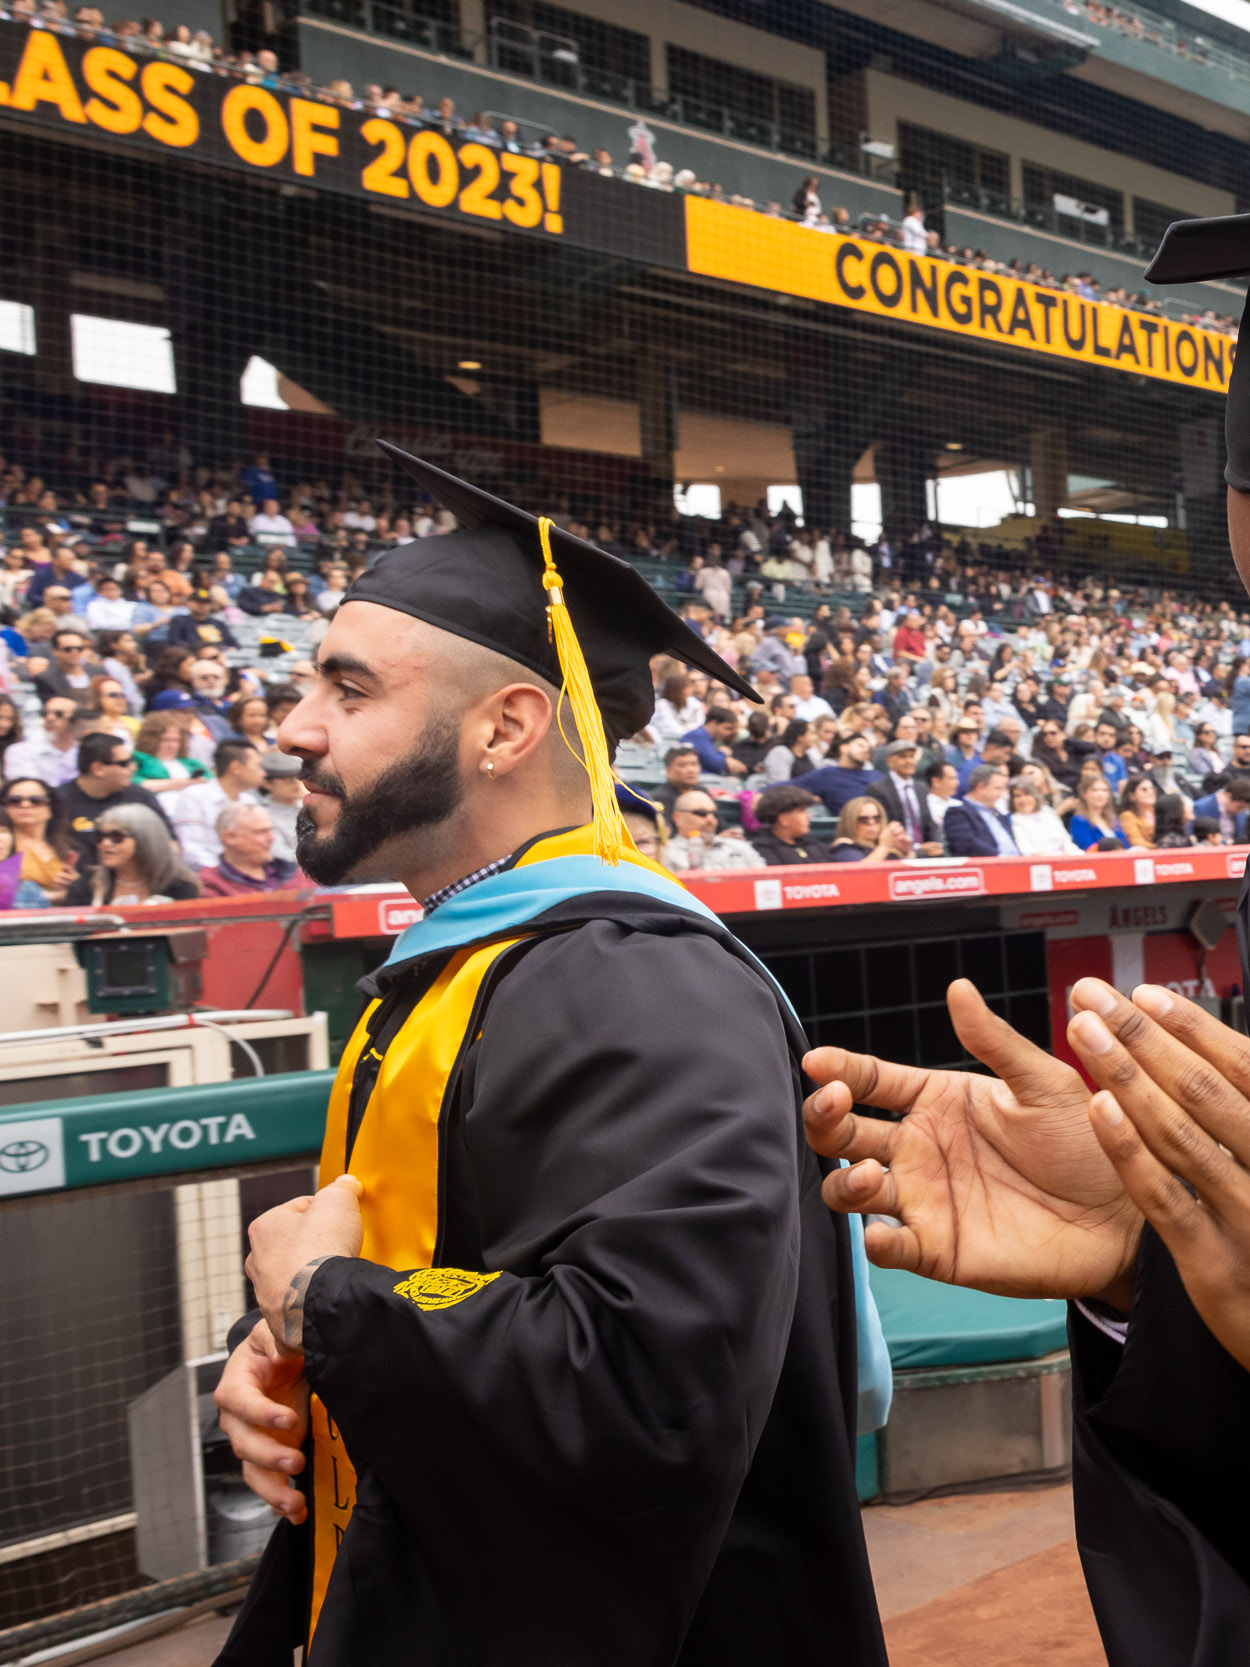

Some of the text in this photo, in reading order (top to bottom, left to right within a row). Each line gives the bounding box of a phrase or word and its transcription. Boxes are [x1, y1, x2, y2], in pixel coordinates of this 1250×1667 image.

[0, 29, 564, 234] ASS OF 2023!
[1053, 868, 1098, 883] TOYOTA
[1154, 862, 1195, 876] TOYOTA
[783, 883, 840, 900] TOYOTA
[894, 875, 979, 895] angels.com
[1109, 904, 1169, 929] ANGELS
[79, 1113, 256, 1163] TOYOTA
